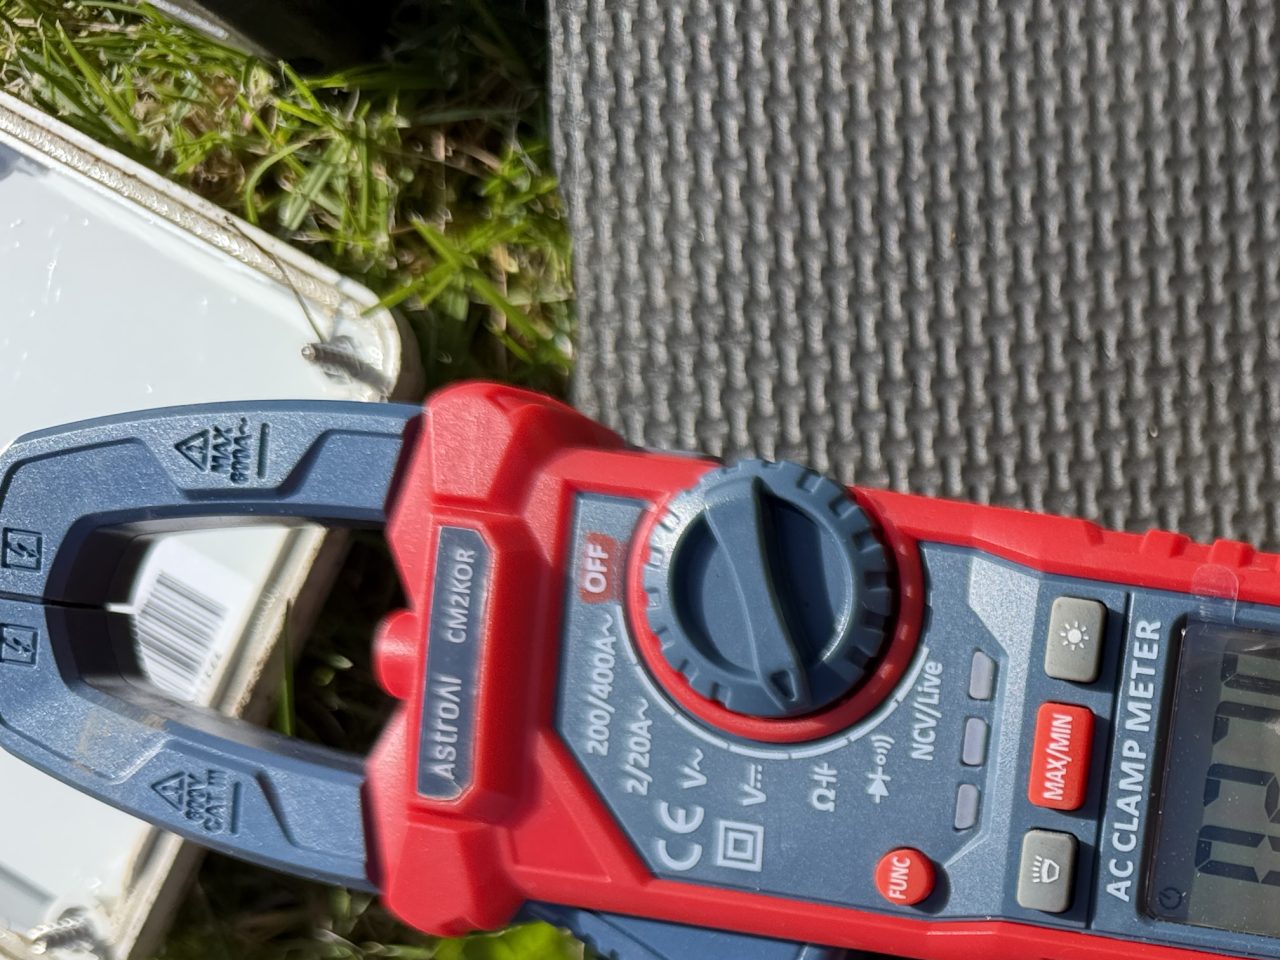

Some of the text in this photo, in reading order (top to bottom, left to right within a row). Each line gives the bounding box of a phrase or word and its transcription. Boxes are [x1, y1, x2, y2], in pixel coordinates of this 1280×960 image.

[210, 426, 232, 474] MAX
[585, 544, 608, 594] OFF
[429, 675, 462, 780] AstroAI
[910, 660, 943, 761] NCV/Live
[1043, 713, 1073, 801] MAX/MIN
[1106, 619, 1161, 902] AC CLAMP METER
[204, 793, 226, 834] CAT
[656, 801, 705, 871] CE
[889, 855, 911, 900] FUNC
